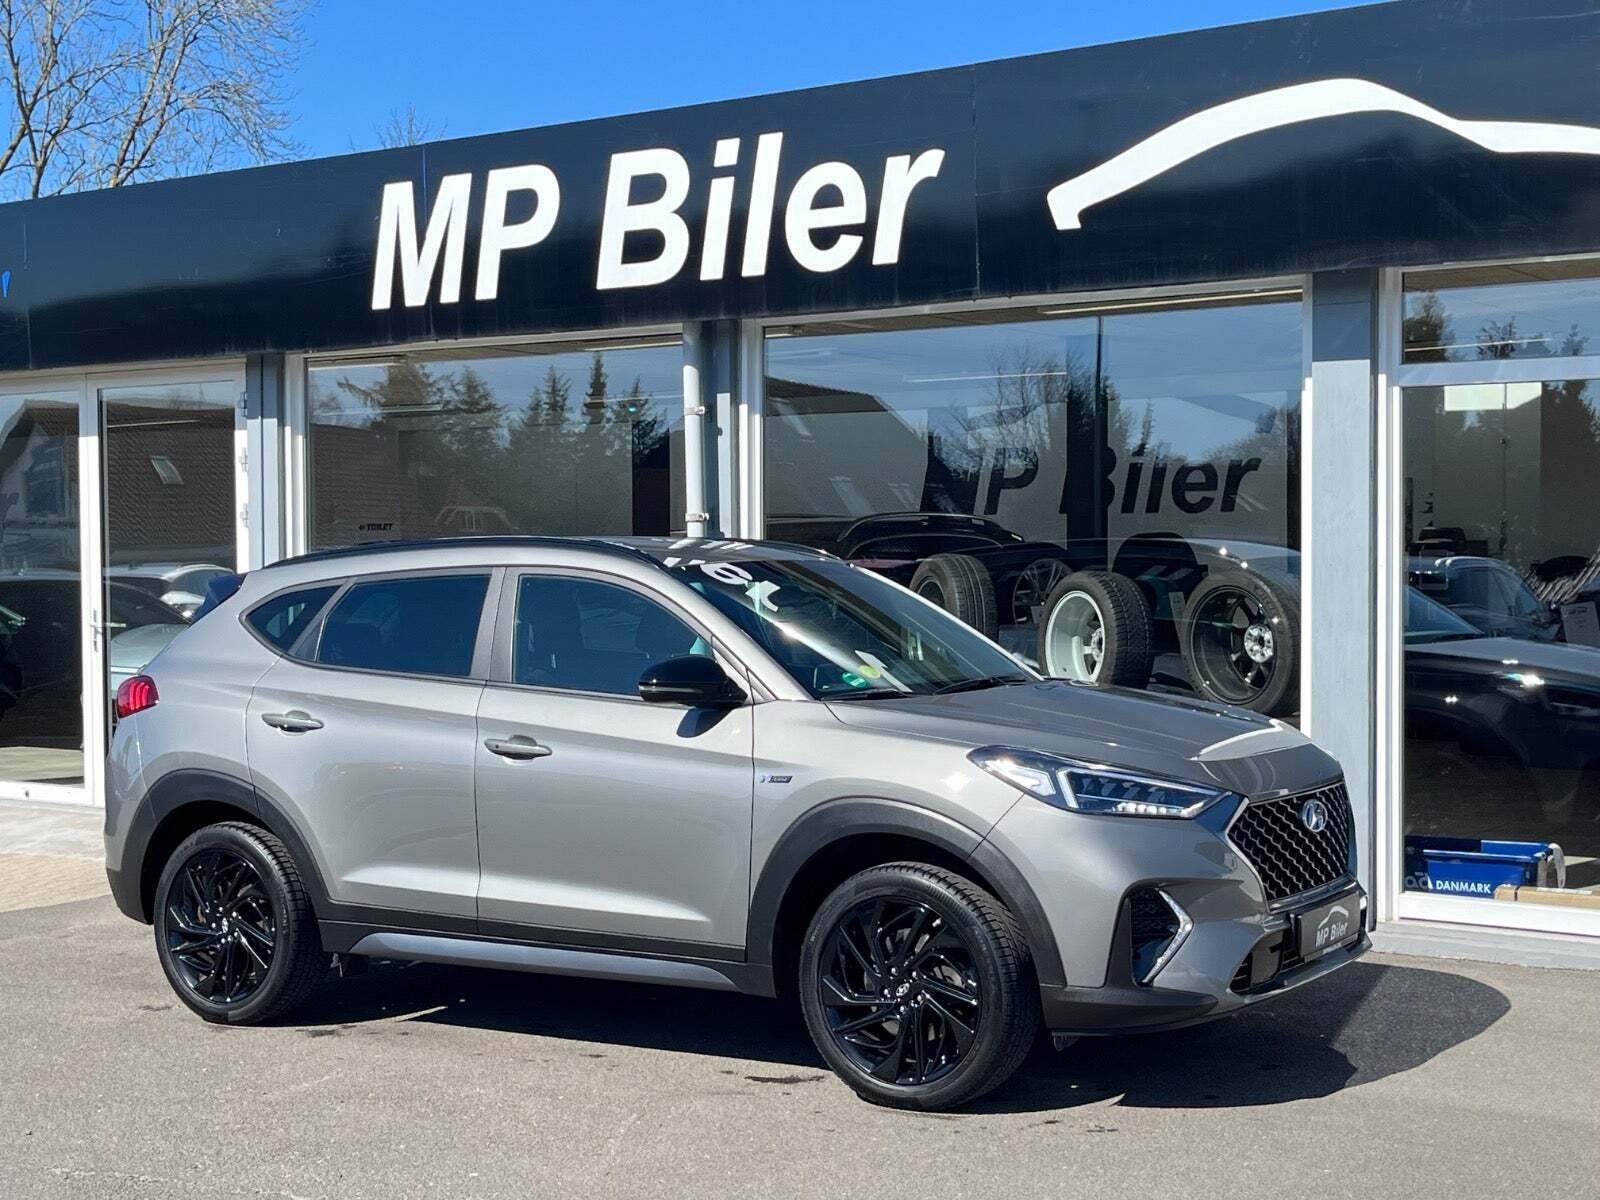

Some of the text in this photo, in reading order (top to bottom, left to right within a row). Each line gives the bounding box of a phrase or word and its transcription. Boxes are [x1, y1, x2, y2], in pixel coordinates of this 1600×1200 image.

[372, 131, 945, 311] MP Biler
[367, 523, 393, 531] TOILET
[1436, 881, 1491, 894] DANMARK
[1316, 922, 1348, 946] MP Biler
